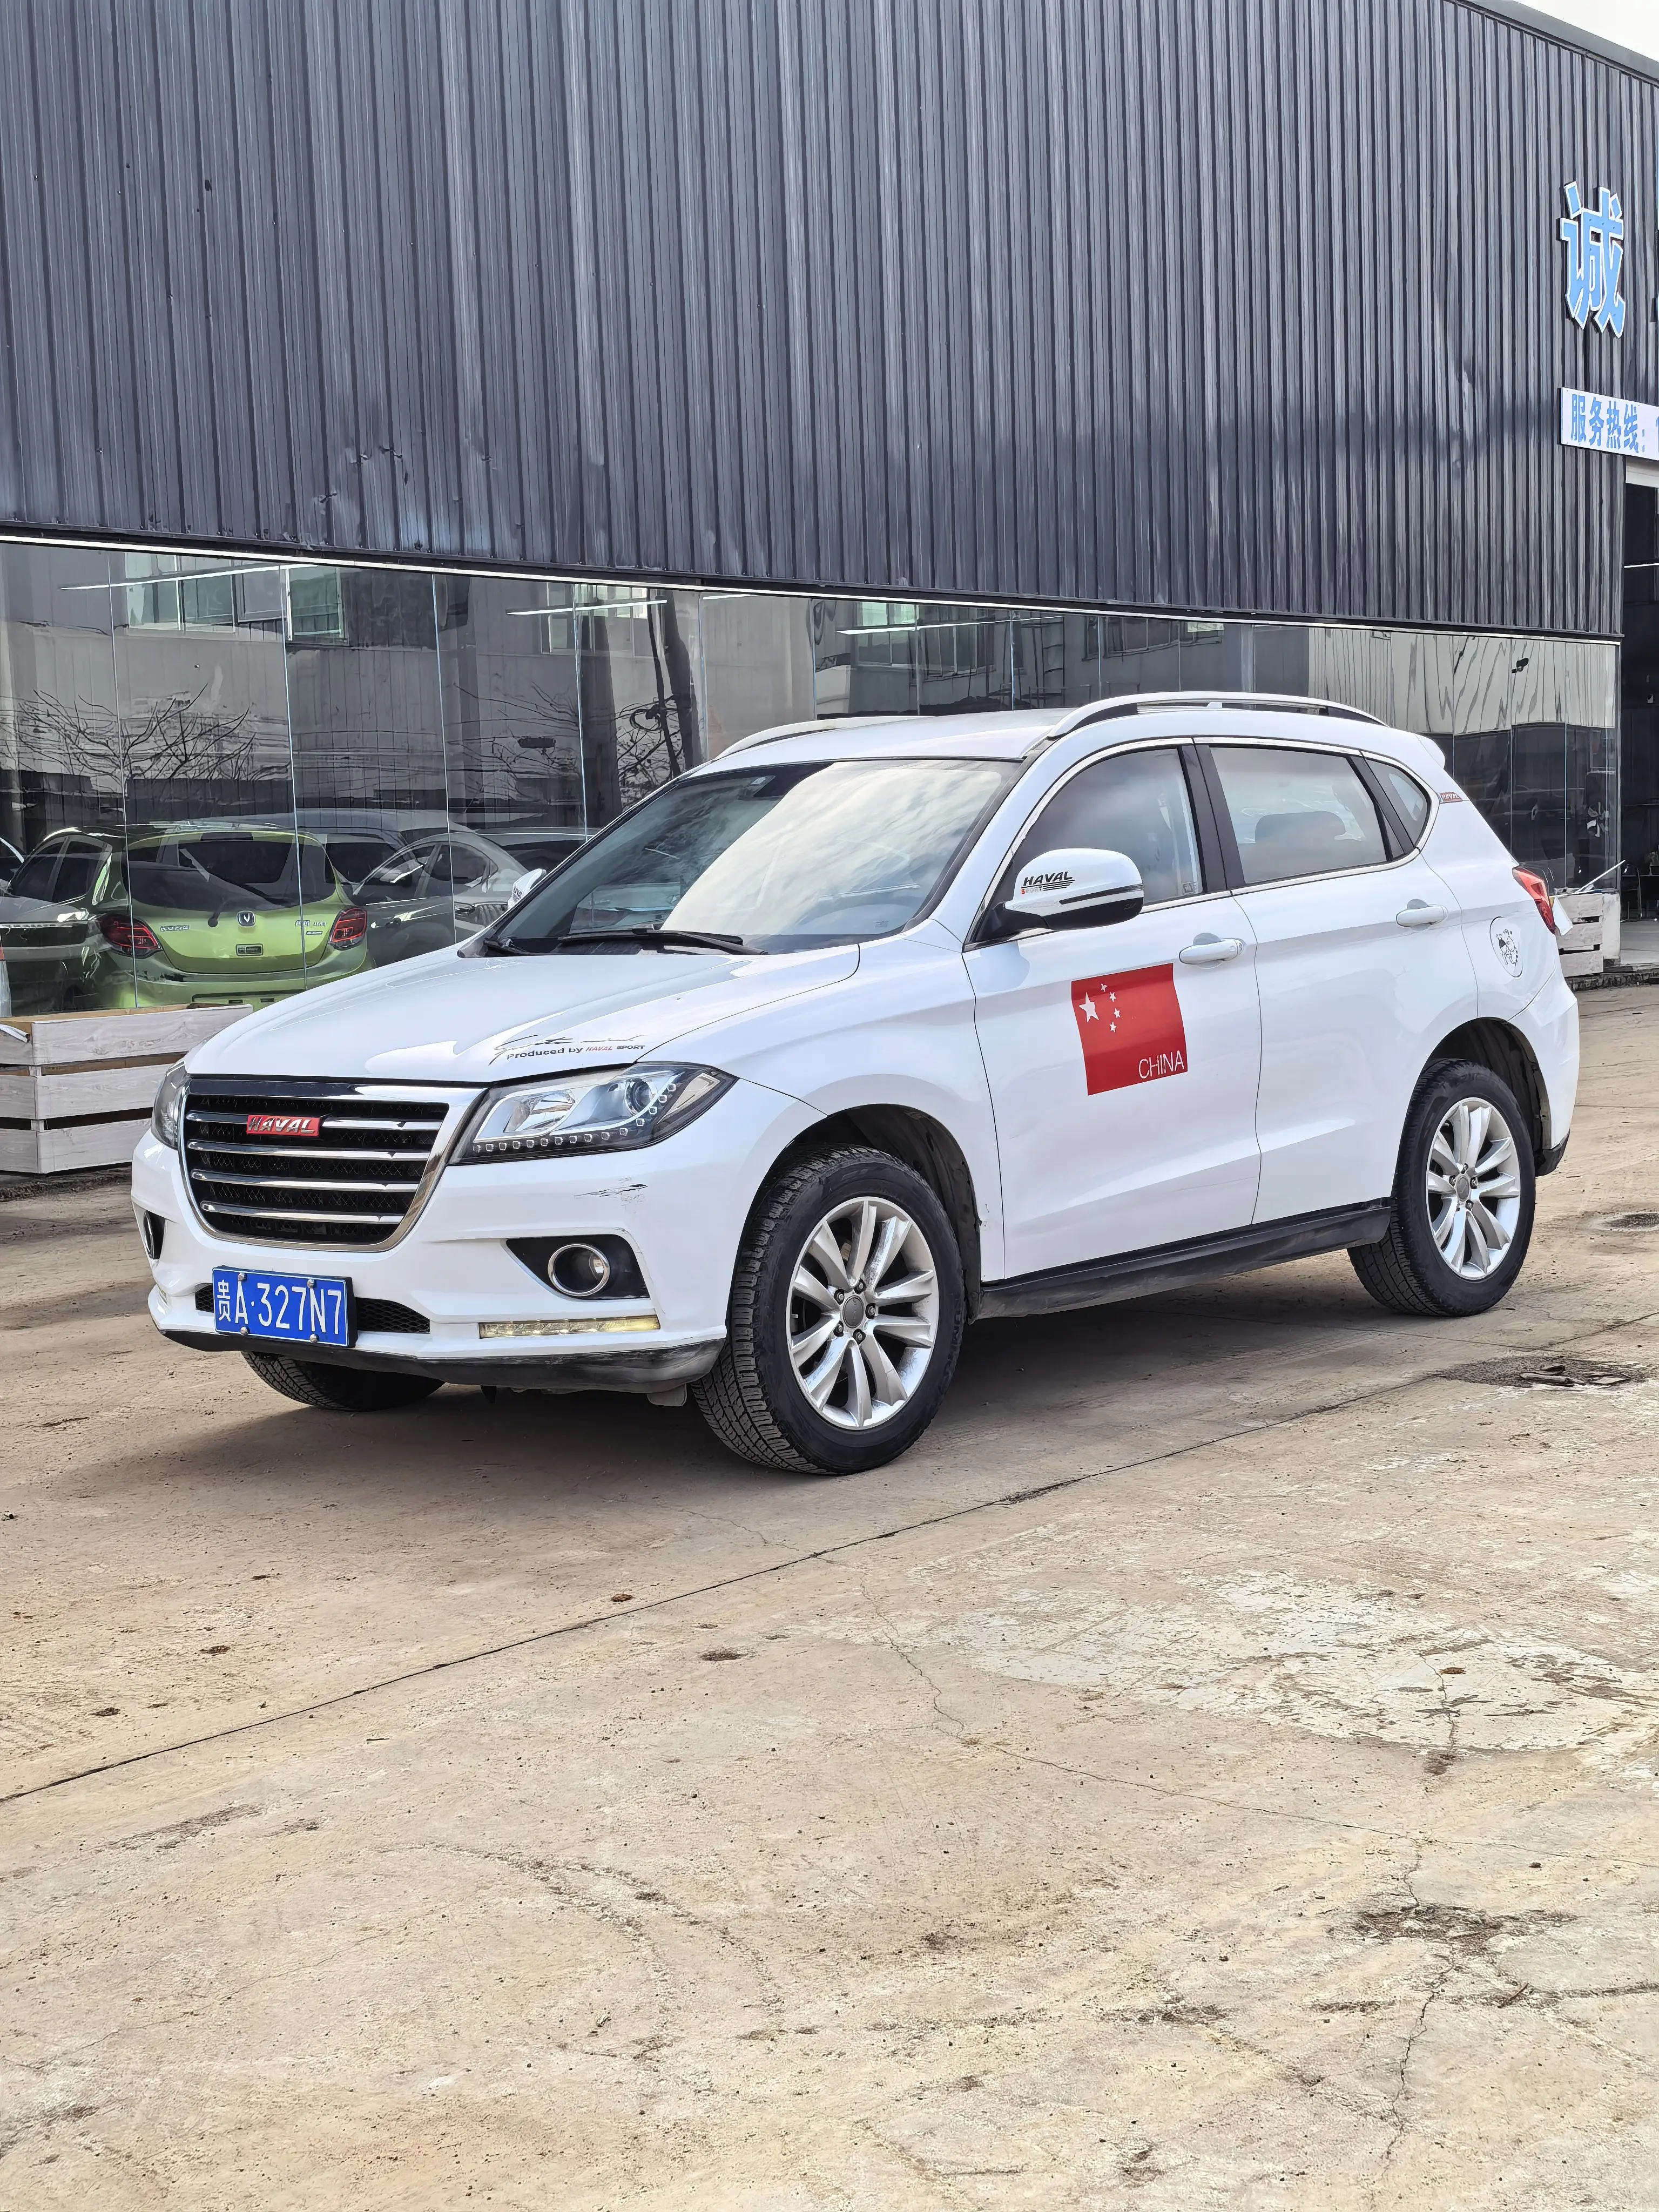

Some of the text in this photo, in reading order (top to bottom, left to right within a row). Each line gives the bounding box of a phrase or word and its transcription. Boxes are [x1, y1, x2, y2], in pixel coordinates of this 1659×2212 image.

[1561, 181, 1626, 339] 诚
[1023, 871, 1073, 886] HAVAL
[507, 1048, 565, 1060] Produced
[1138, 1050, 1185, 1079] CHINA
[248, 1117, 315, 1134] HAVAL
